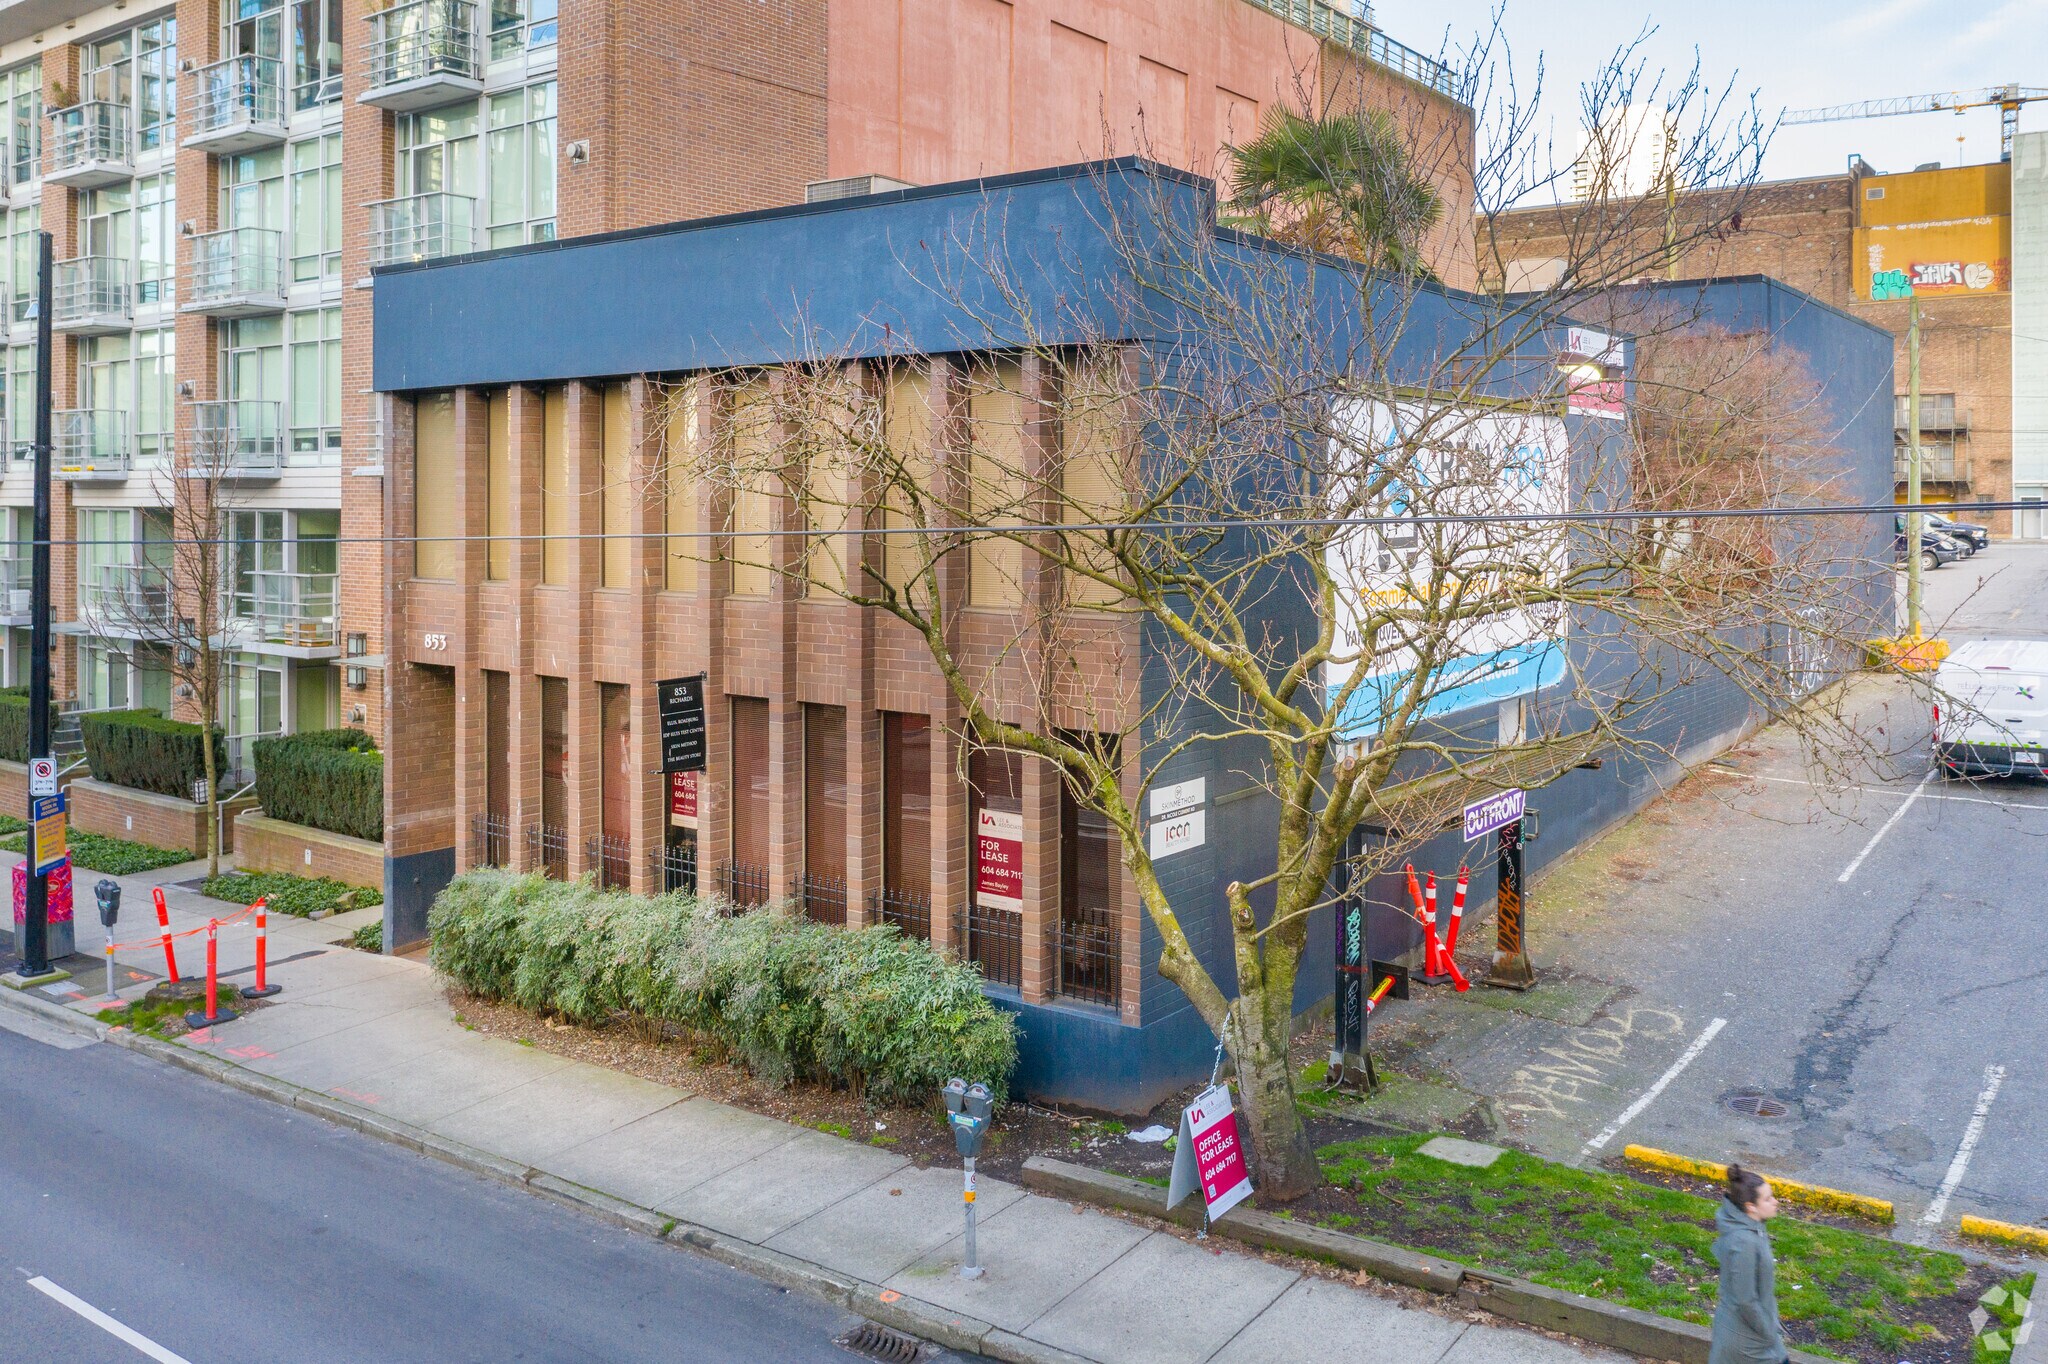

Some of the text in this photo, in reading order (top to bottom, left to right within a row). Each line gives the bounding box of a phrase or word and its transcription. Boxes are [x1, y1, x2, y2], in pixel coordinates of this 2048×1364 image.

[424, 633, 447, 651] 853
[674, 686, 687, 696] 853
[669, 695, 693, 705] RICHARDS
[674, 777, 695, 789] LEASE
[674, 790, 696, 800] 604 684
[1467, 791, 1522, 834] OUTFRONT
[999, 823, 1023, 831] ASSOCIATE
[981, 840, 1000, 851] FOR
[981, 850, 1009, 863] LEASE
[981, 865, 994, 875] 604
[995, 867, 1009, 878] 684
[1199, 1130, 1222, 1152] OFFICE
[1201, 1135, 1234, 1165] FOR LEASE
[1205, 1167, 1215, 1181] 604
